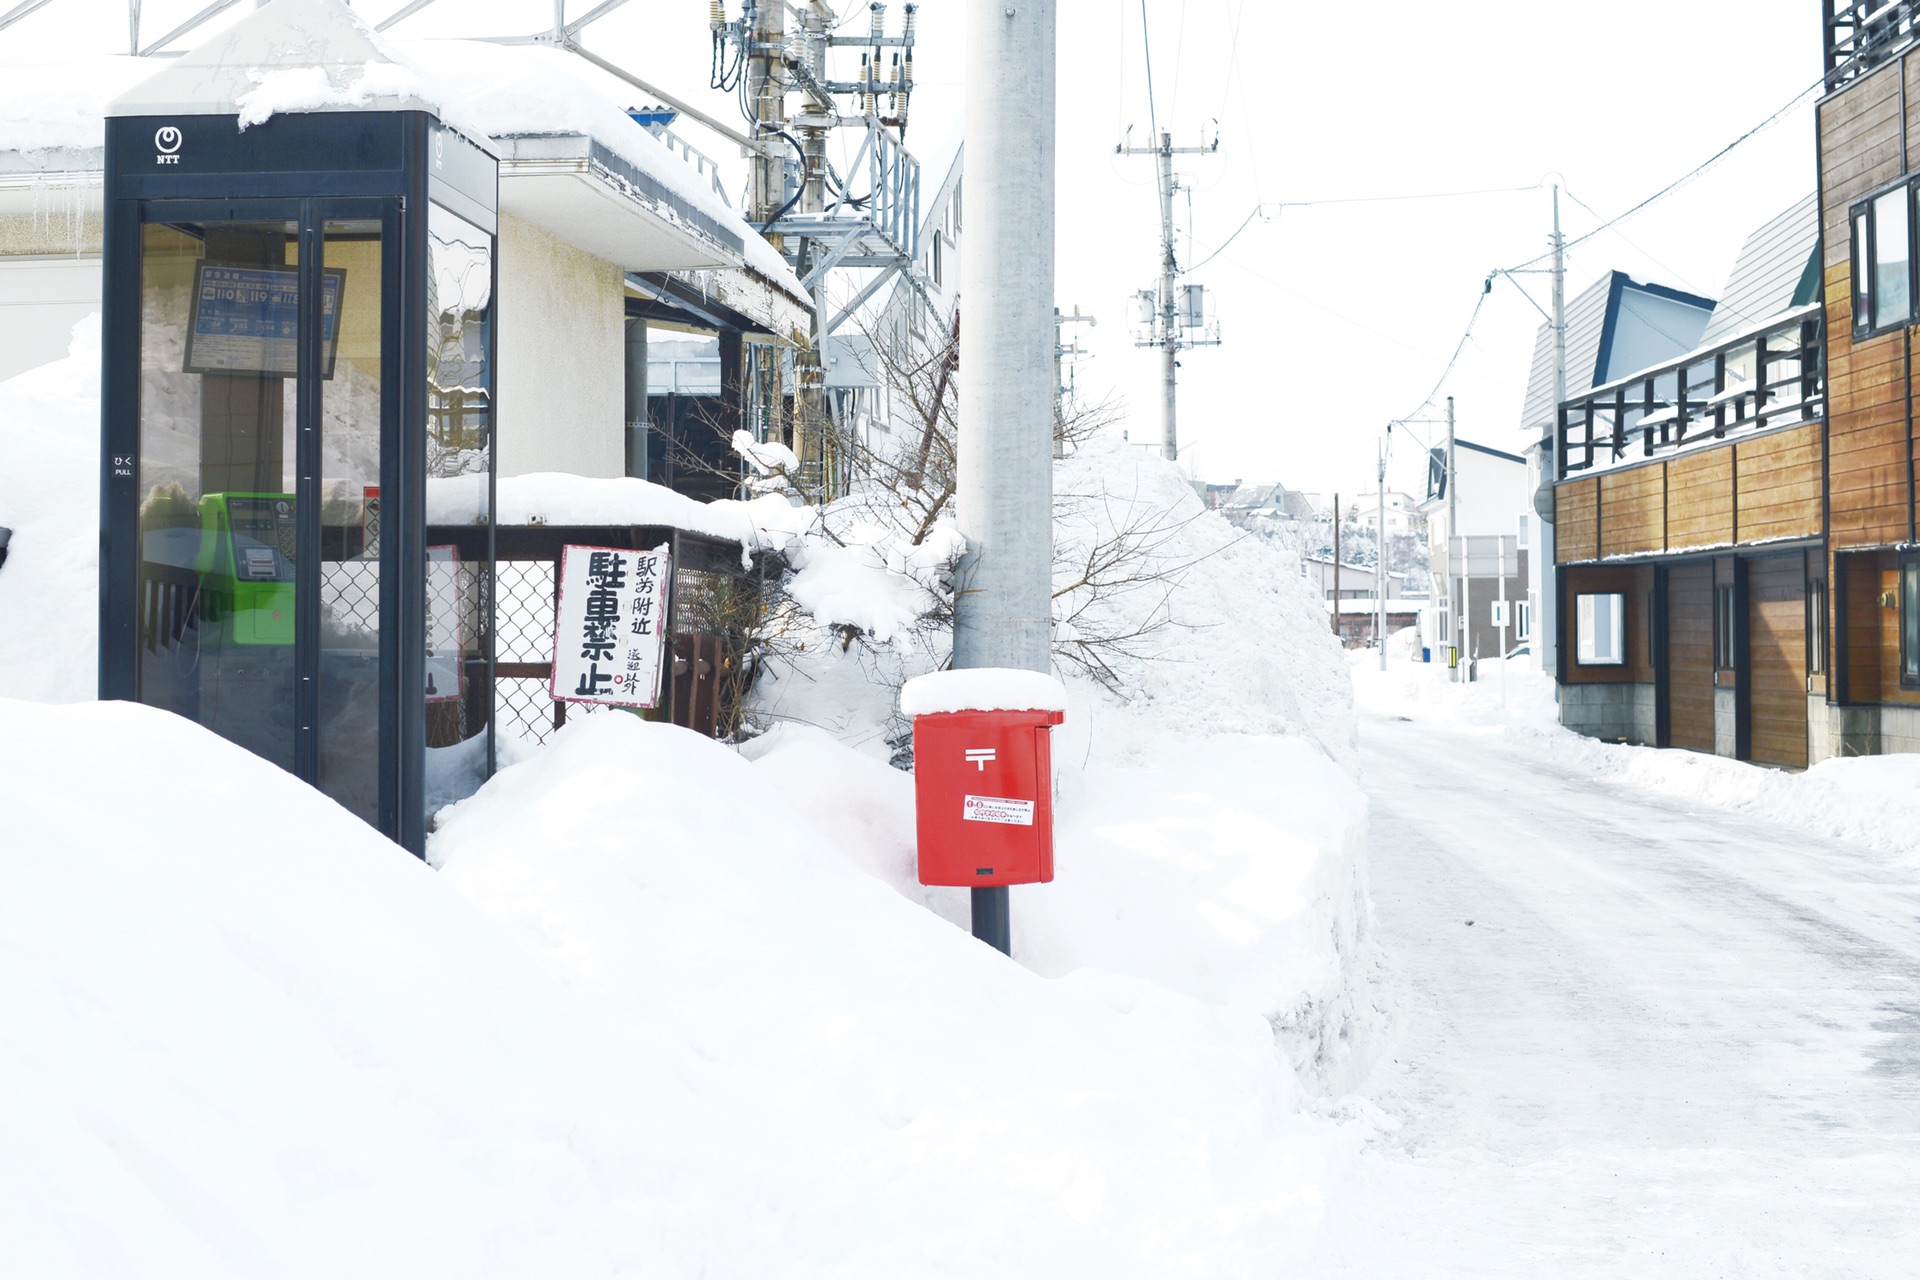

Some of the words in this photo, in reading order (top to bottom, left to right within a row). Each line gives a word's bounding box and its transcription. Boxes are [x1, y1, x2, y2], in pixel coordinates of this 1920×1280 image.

[156, 154, 180, 164] NTT
[217, 289, 234, 300] 110
[250, 290, 268, 302] 119
[114, 456, 132, 466] ひく
[115, 468, 132, 476] PULL
[575, 552, 627, 696] 駐車禁止
